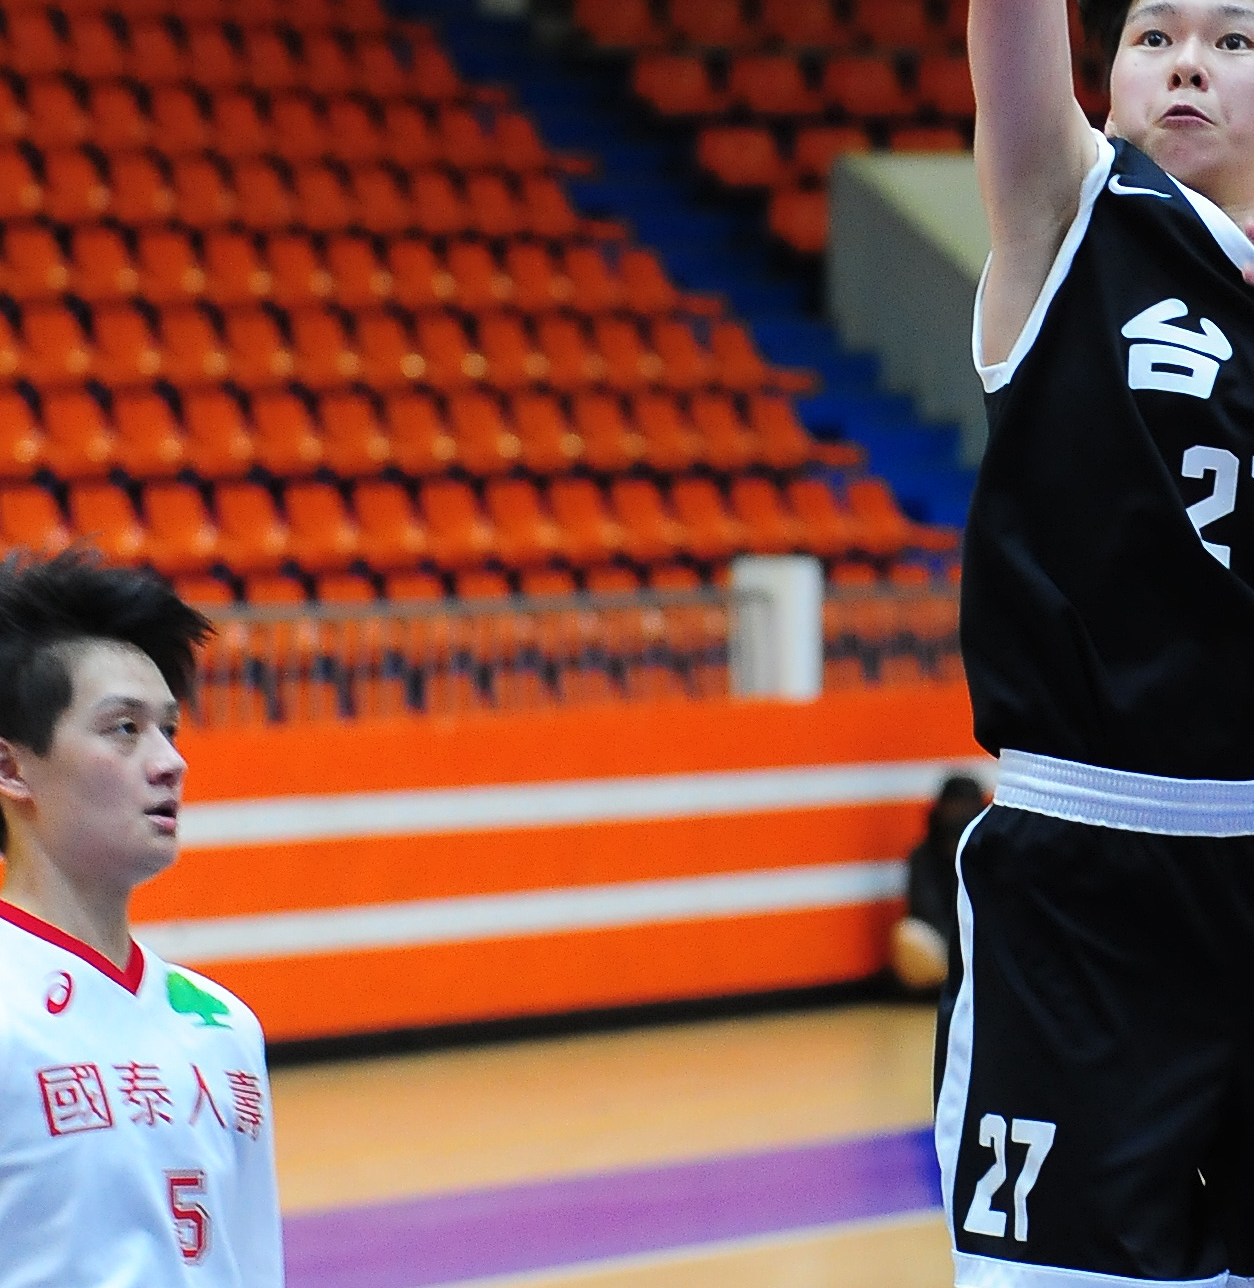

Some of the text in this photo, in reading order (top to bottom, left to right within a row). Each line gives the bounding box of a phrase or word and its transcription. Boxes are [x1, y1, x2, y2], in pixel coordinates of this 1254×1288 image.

[36, 1060, 265, 1142] 國泰人壽
[163, 1168, 212, 1265] 5
[963, 1112, 1057, 1243] 27
